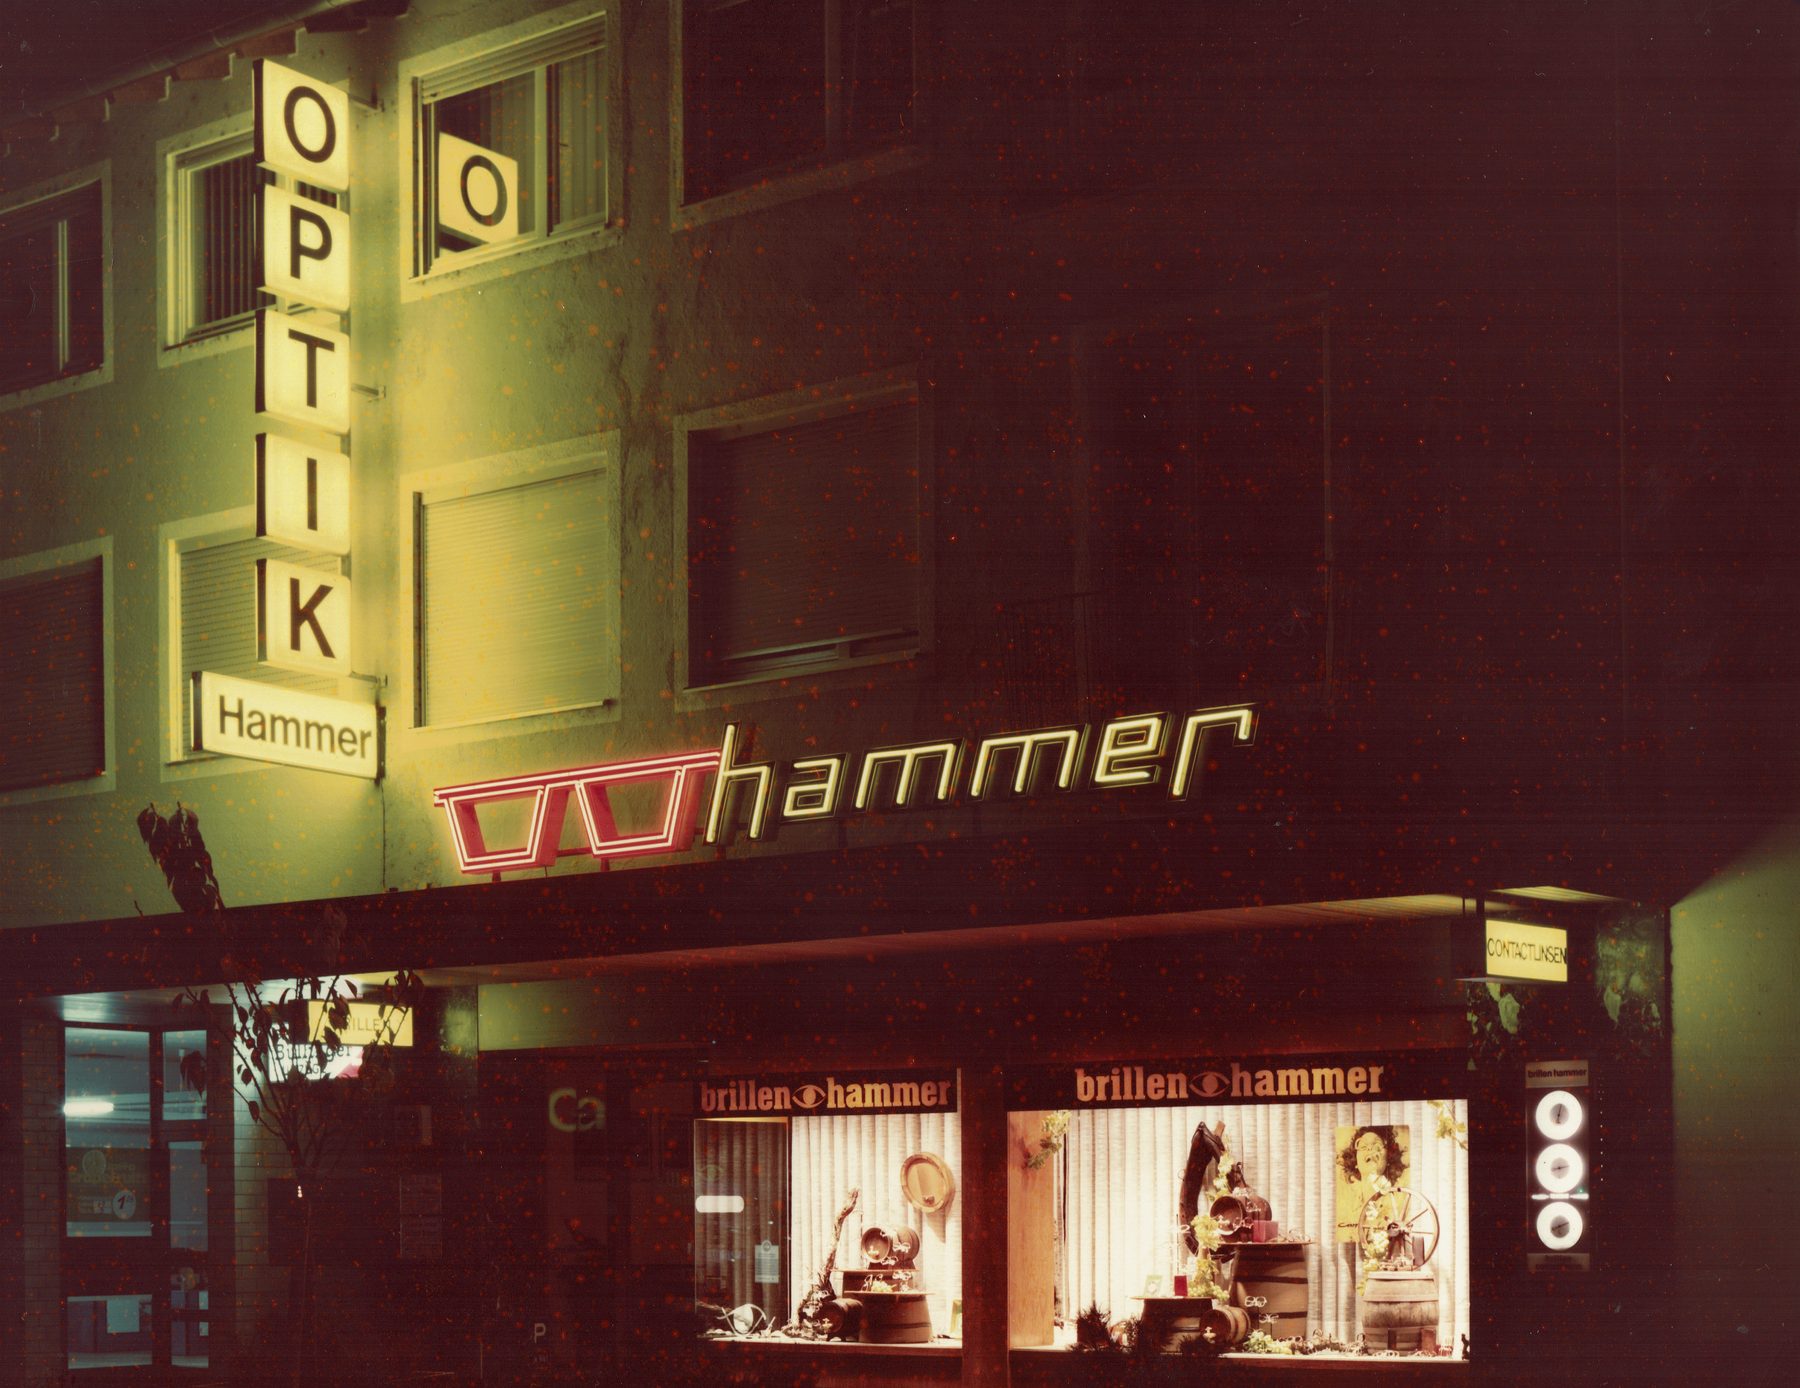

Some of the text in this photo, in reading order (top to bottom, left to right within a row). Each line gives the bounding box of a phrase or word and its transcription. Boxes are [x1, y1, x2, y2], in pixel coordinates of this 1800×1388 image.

[284, 86, 336, 659] OPTIK
[219, 694, 372, 759] Hammer
[703, 704, 1254, 846] hammer
[1487, 938, 1568, 965] CONTACTLINSEN
[1074, 1062, 1385, 1101] brillen hammer
[1528, 1068, 1588, 1078] brillen hammer
[700, 1076, 952, 1112] brillen hammer
